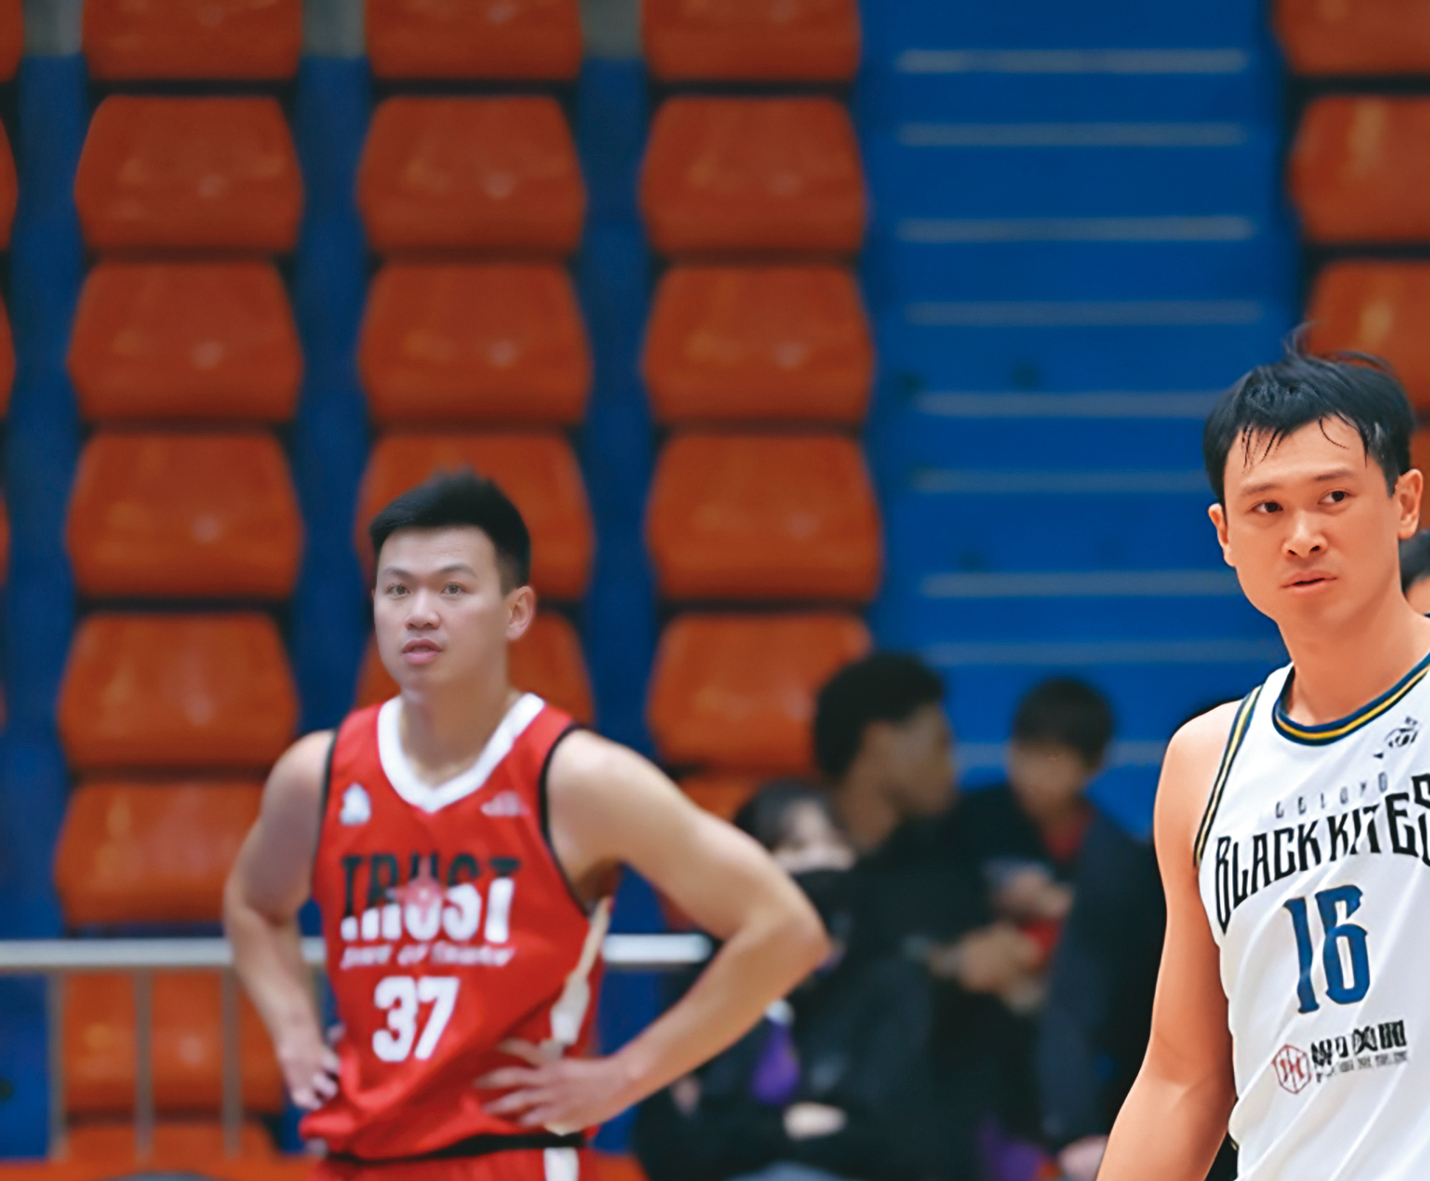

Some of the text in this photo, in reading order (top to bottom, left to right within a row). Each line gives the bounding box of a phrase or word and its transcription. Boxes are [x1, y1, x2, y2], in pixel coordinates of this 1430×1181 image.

[1215, 818, 1322, 935] BLACK
[1283, 884, 1371, 1015] 16
[372, 975, 460, 1062] 37
